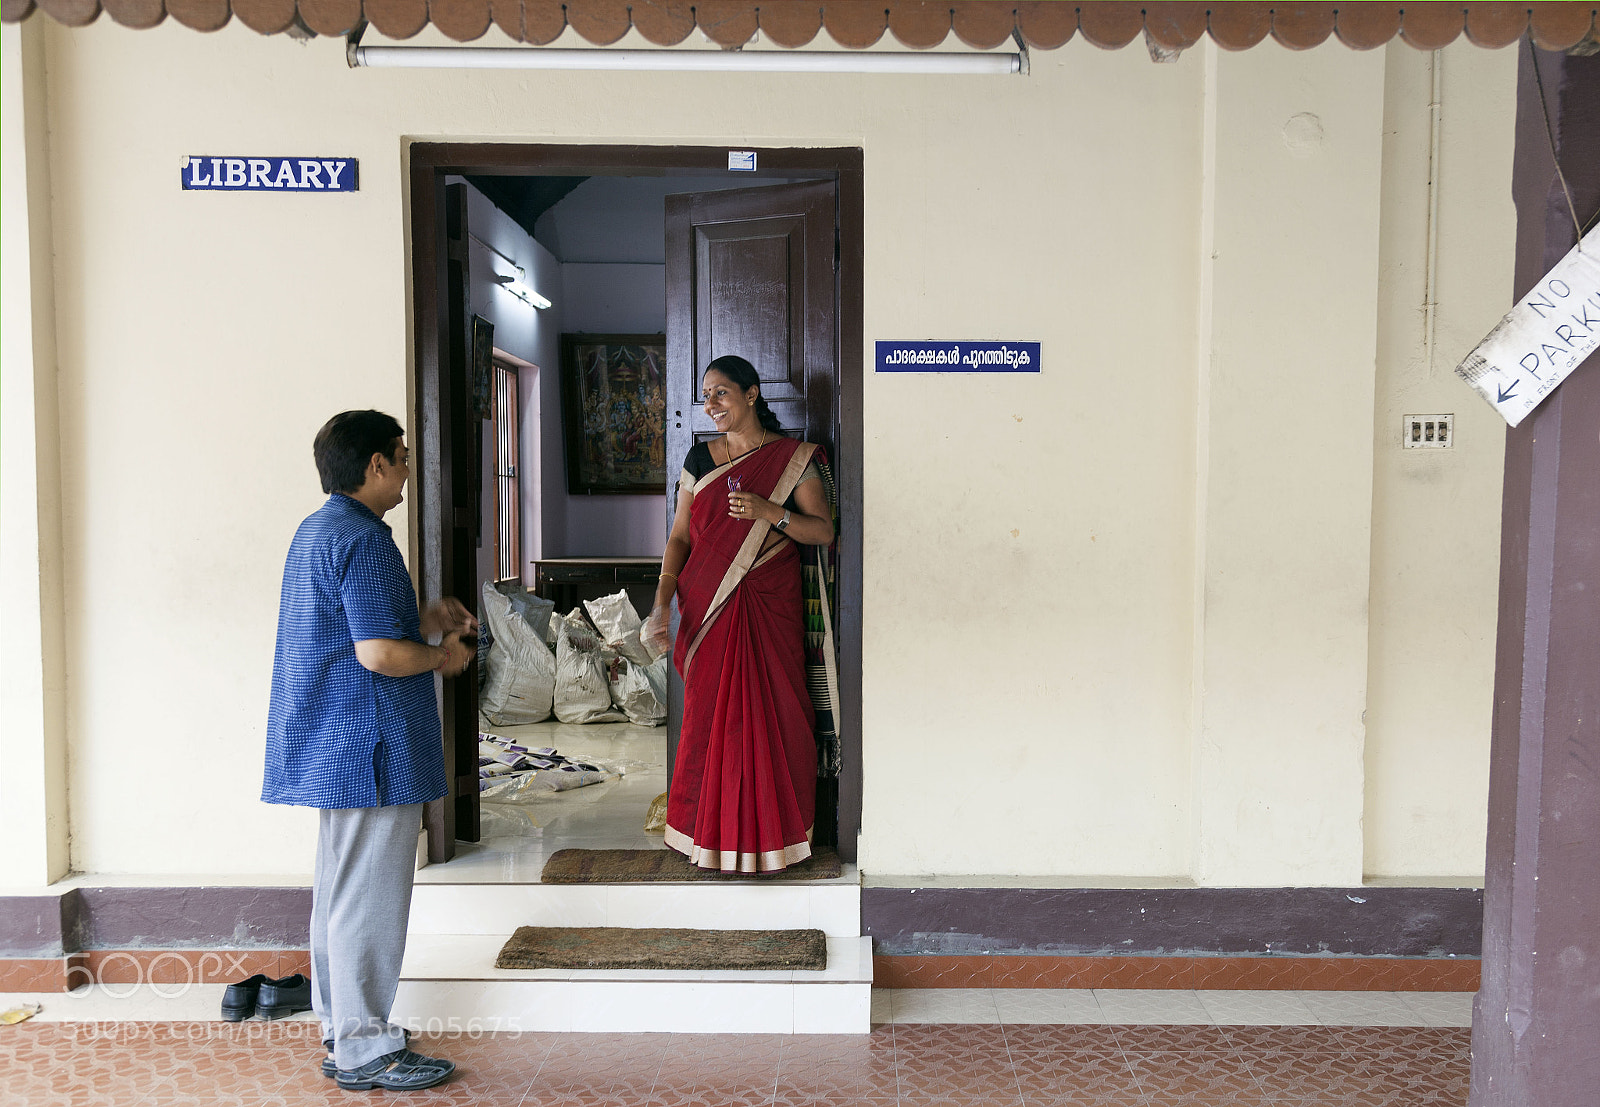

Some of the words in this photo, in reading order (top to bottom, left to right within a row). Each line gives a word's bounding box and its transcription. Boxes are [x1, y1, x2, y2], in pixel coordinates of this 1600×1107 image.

[190, 158, 347, 189] LIBRARY
[1527, 279, 1571, 319] NO
[1519, 291, 1600, 381] PARKI
[885, 345, 960, 365] പാദരക്ഷകൾ
[962, 345, 1031, 369] പുറത്തിടുക
[1537, 372, 1561, 396] FRONT
[1565, 356, 1577, 369] OF
